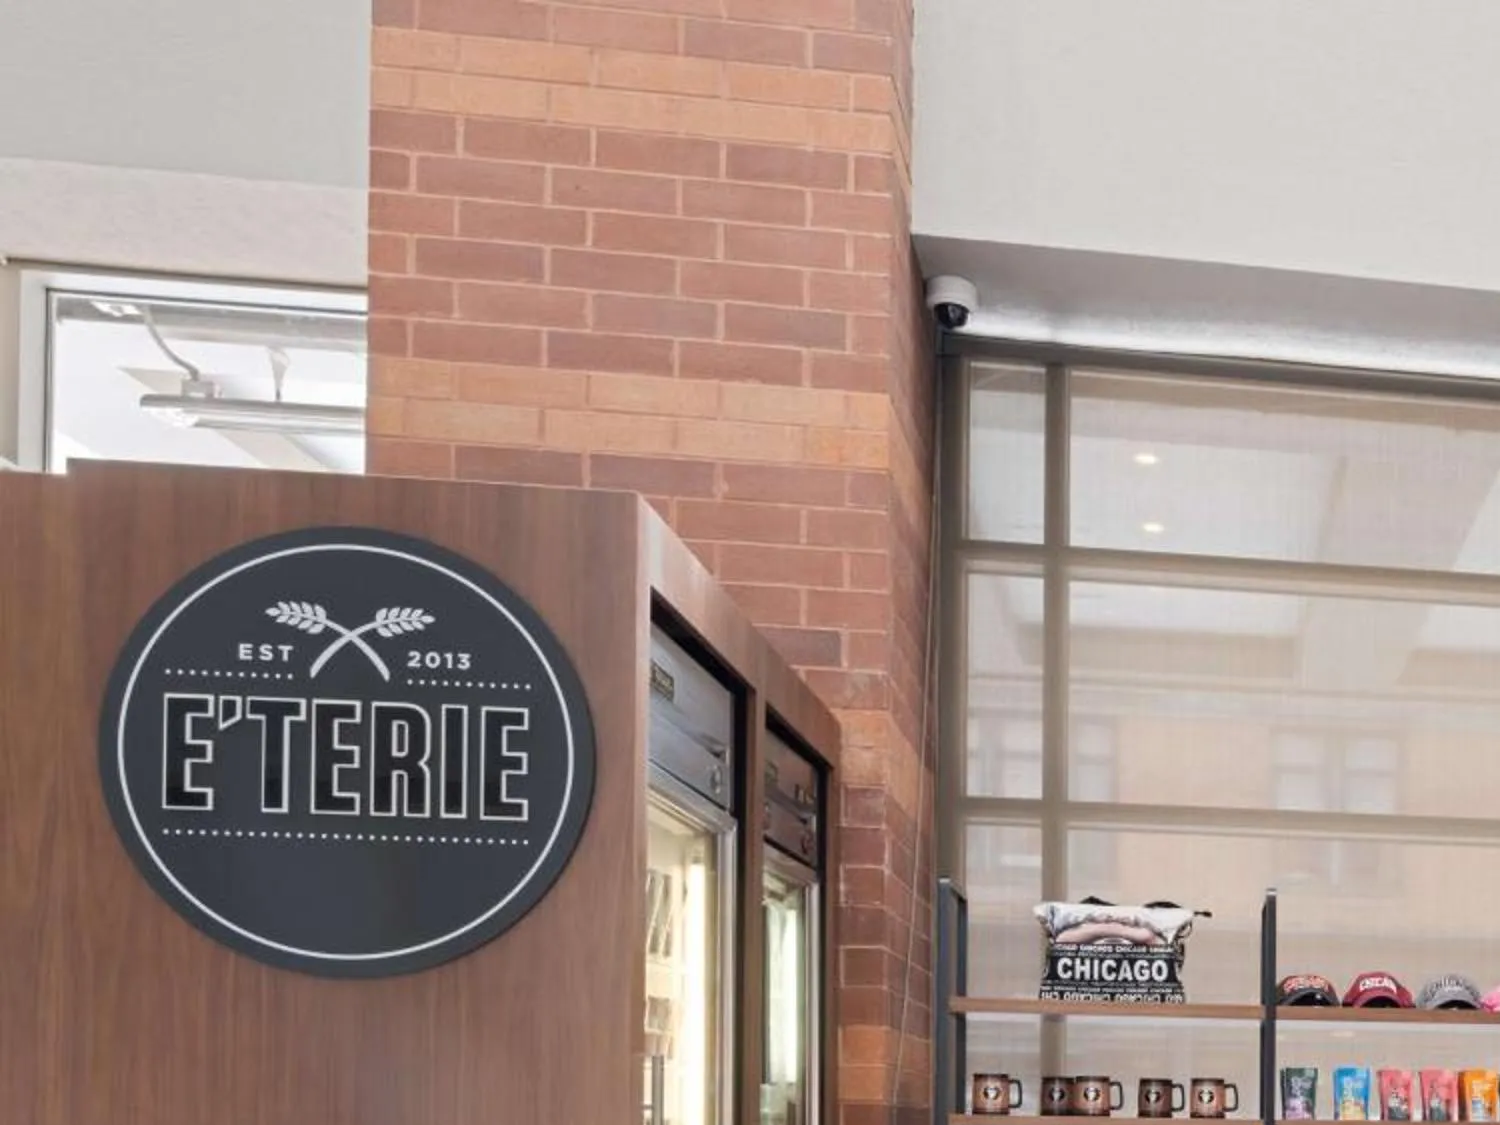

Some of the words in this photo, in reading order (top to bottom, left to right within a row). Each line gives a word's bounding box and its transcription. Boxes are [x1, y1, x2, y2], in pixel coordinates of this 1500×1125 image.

[238, 643, 294, 662] EST
[408, 651, 472, 670] 2013
[162, 692, 530, 822] E'TERIE
[1056, 958, 1169, 982] CHICAGO
